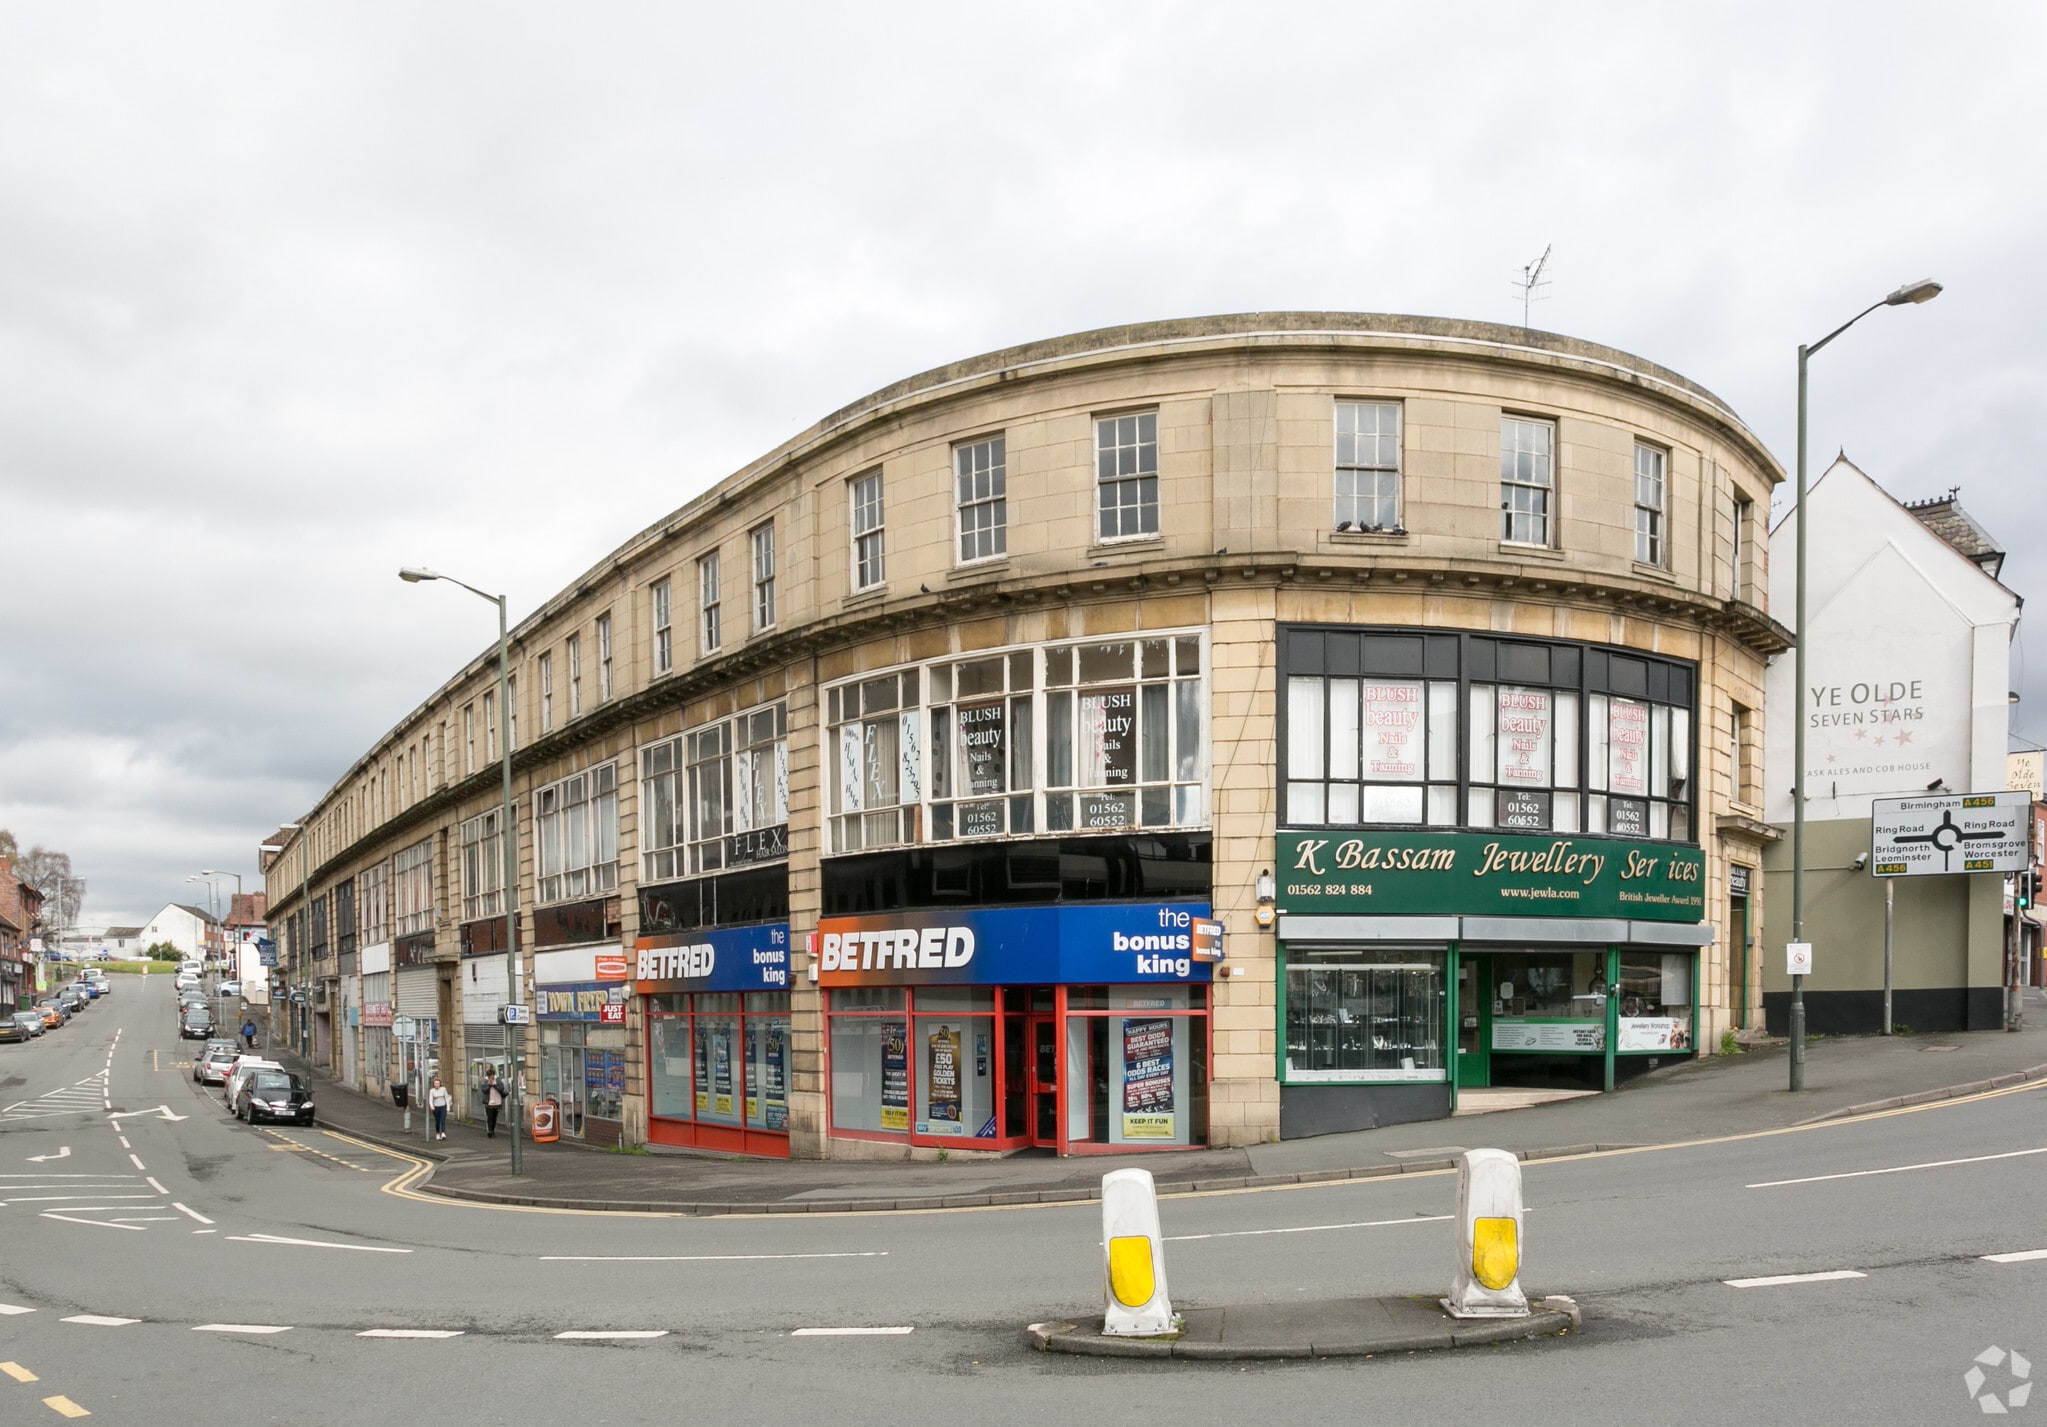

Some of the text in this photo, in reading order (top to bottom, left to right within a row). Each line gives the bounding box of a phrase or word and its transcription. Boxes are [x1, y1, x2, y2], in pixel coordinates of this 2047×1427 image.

[1365, 687, 1419, 701] BLUSH
[1810, 680, 1922, 707] YE OLDE
[1082, 694, 1131, 710] BLUSH
[1501, 693, 1546, 711] BLUSH
[960, 707, 1001, 723] BLUSH
[1365, 702, 1419, 731] beauty
[1612, 704, 1646, 722] BLUSH
[1810, 706, 1924, 728] SEVEN STARS
[1082, 714, 1132, 737] beauty
[1501, 708, 1547, 739] beauty
[960, 723, 1002, 748] beauty
[1378, 732, 1407, 744] Nails
[1612, 718, 1646, 749] beauty
[1512, 738, 1537, 751] Nails
[969, 751, 992, 762] Nails
[1387, 746, 1399, 758] &
[1519, 752, 1529, 765] &
[1619, 748, 1638, 761] Nails
[976, 765, 984, 776] &
[1371, 760, 1415, 775] Tanning
[1505, 765, 1543, 781] Tanning
[1803, 762, 1931, 778] ASK ALES AND COB HOUSE
[1614, 775, 1642, 790] Tanning
[1516, 792, 1531, 801] Tel:
[1089, 803, 1125, 814] 01562
[1507, 802, 1539, 814] 01562
[1900, 798, 1995, 810] Birmingham A456
[967, 812, 997, 823] 01562
[1089, 816, 1125, 827] 60552
[1507, 815, 1539, 826] 60552
[1616, 810, 1640, 821] 01562
[967, 824, 997, 835] 60552
[1616, 823, 1640, 833] 60552
[1875, 825, 1925, 835] Ring Road
[1964, 819, 2015, 830] Ring Road
[734, 828, 782, 855] FLEX
[1964, 840, 2026, 850] Bromsgrove
[1875, 844, 1930, 854] Bridgnorth
[1964, 850, 2019, 859] Worcester
[1293, 839, 1329, 876] K
[1335, 839, 1456, 871] Bassam
[1473, 841, 1605, 885] Jewellery
[1875, 854, 1932, 863] Leominster
[1965, 860, 1994, 870] A451
[1877, 864, 1907, 873] A456
[1287, 884, 1373, 895] 01562 824 884
[1501, 887, 1580, 900] www.jewla.com
[1619, 891, 1643, 902] British
[1644, 893, 1670, 904] Jeweller
[1671, 895, 1689, 905] Award
[1158, 908, 1190, 928] the
[1196, 923, 1221, 936] BETFRED
[771, 928, 784, 945] the
[1113, 931, 1190, 951] bonus
[821, 926, 975, 971] BETFRED
[637, 943, 715, 980] BETFRED
[753, 949, 785, 964] bonus
[1137, 954, 1191, 977] king
[763, 967, 785, 985] king
[547, 991, 575, 1012] TOWN
[603, 1005, 623, 1013] JUST
[608, 1012, 623, 1020] EAT
[1126, 1036, 1170, 1050] GUARANTEED
[1130, 1031, 1166, 1043] BEST ODDS
[935, 1053, 953, 1065] £50
[1142, 1059, 1160, 1068] BEST
[933, 1070, 955, 1078] GOLDEN
[1127, 1063, 1170, 1077] ODDS RACES
[933, 1077, 956, 1085] TICKETS
